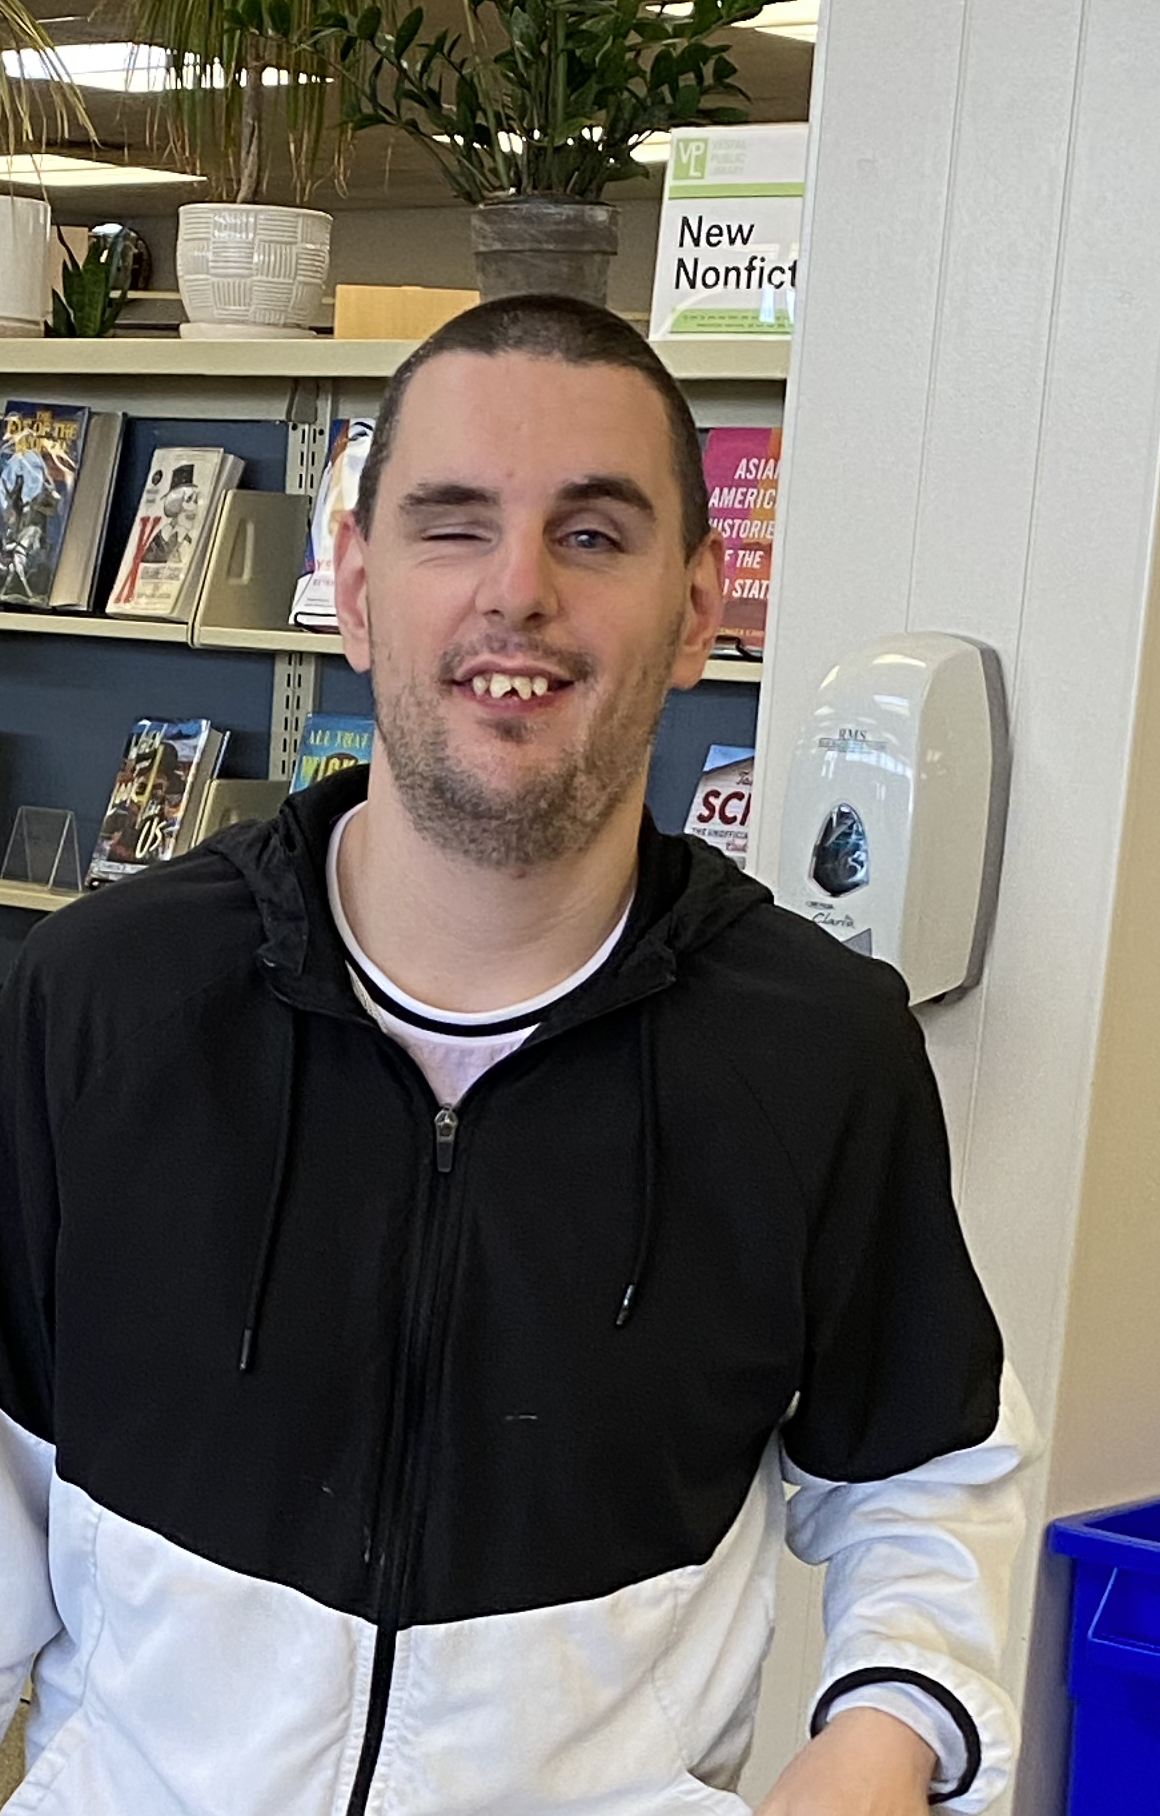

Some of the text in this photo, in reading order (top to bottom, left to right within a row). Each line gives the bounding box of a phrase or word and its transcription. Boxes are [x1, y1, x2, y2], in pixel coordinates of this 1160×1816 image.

[678, 215, 755, 248] New
[708, 486, 777, 509] AMERIC
[735, 550, 764, 569] THE
[732, 578, 771, 599] STAT
[310, 729, 330, 746] ALL
